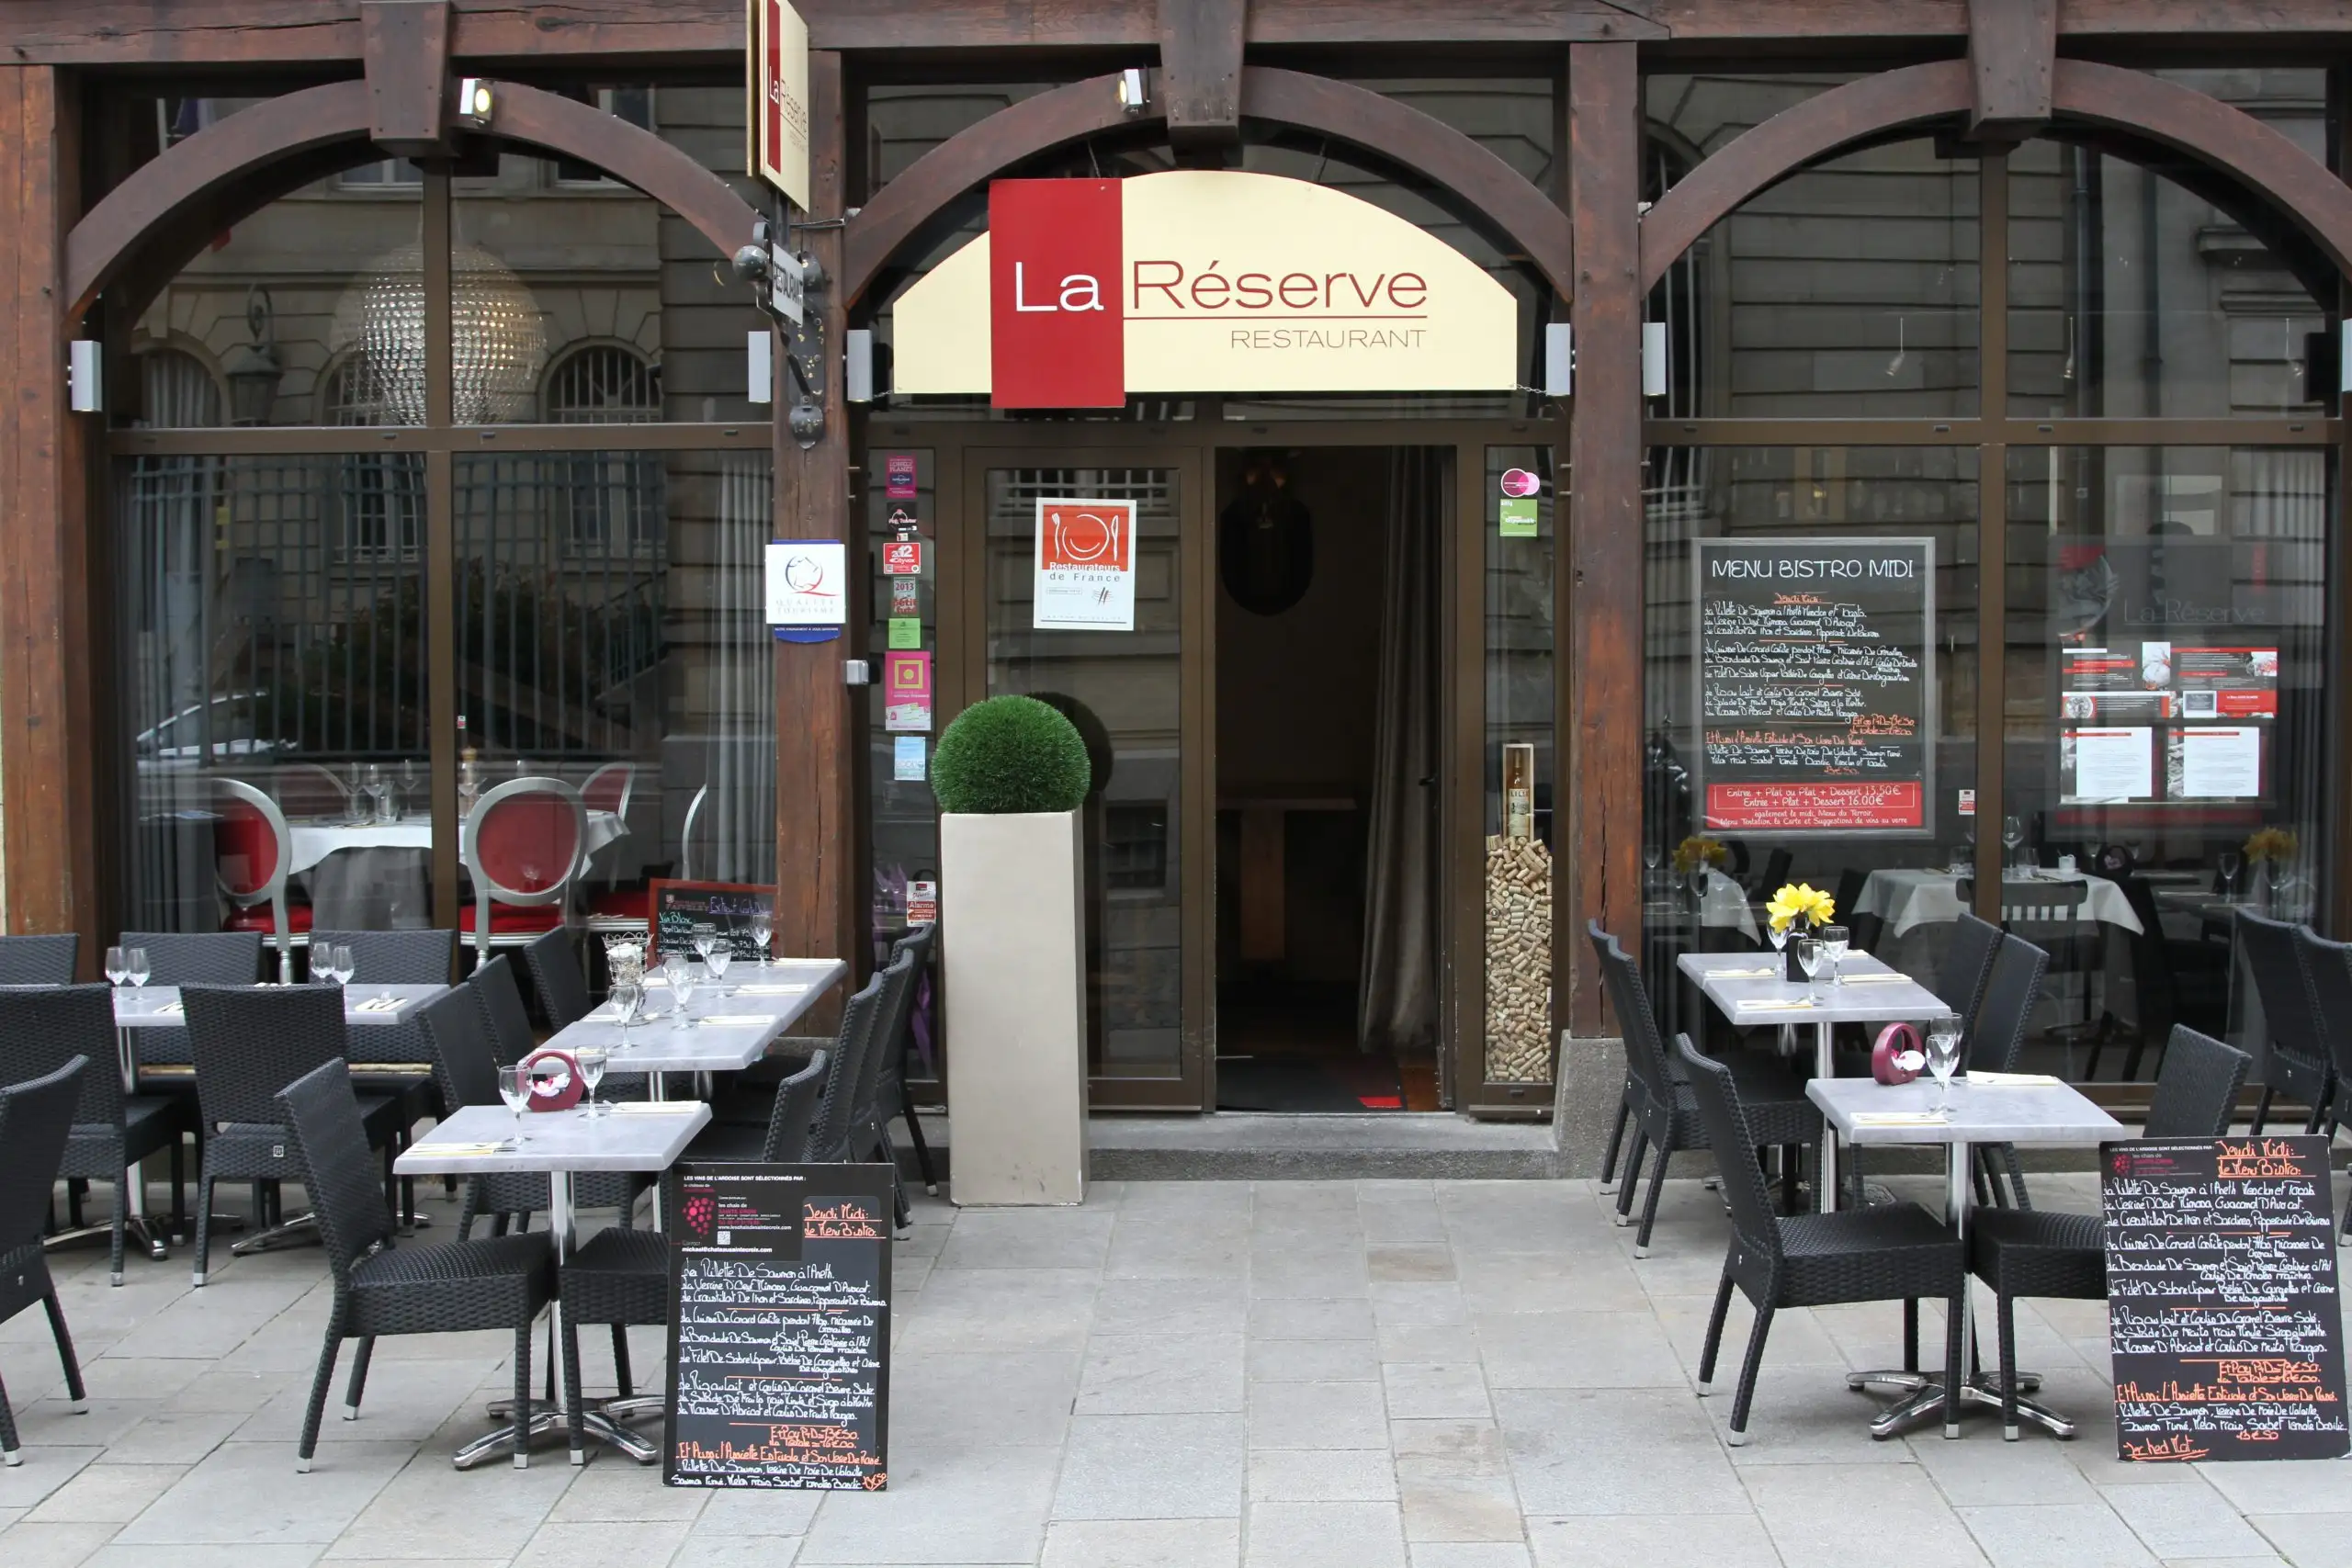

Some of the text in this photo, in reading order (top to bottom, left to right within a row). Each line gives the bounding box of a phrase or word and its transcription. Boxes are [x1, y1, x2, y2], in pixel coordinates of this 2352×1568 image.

[769, 65, 780, 104] La
[780, 78, 808, 134] Réserve
[773, 260, 803, 306] RESTAURANT
[1014, 260, 1428, 312] La Réserve
[1231, 329, 1427, 349] RESTAURANT
[1050, 562, 1121, 571] Restaurateurs
[1713, 559, 1913, 578] MENU BISTRO MIDI
[1049, 572, 1120, 581] de France
[2125, 598, 2264, 622] La Réserve
[1766, 788, 1782, 796] Plat
[1799, 787, 1815, 796] Plat
[1830, 787, 1861, 795] Dessert
[1782, 797, 1799, 807] Plat
[1813, 796, 1845, 806] Dessert
[1849, 795, 1884, 806] 16.00€
[1814, 817, 1852, 826] Suggestions
[2215, 1141, 2256, 1156] Jeudi
[2140, 1180, 2160, 1195] De
[2199, 1183, 2208, 1195] à
[2275, 1181, 2285, 1195] et
[804, 1204, 838, 1219] Jeudi
[2166, 1214, 2183, 1225] De
[2203, 1212, 2212, 1225] et
[2291, 1214, 2304, 1225] De
[734, 1262, 756, 1278] De
[756, 1263, 797, 1279] Saumon
[797, 1268, 806, 1279] à
[2144, 1316, 2158, 1325] au
[2240, 1339, 2258, 1352] De
[2150, 1403, 2170, 1416] De
[2239, 1404, 2257, 1416] De
[2273, 1403, 2289, 1416] De
[2121, 1418, 2161, 1431] Saumon
